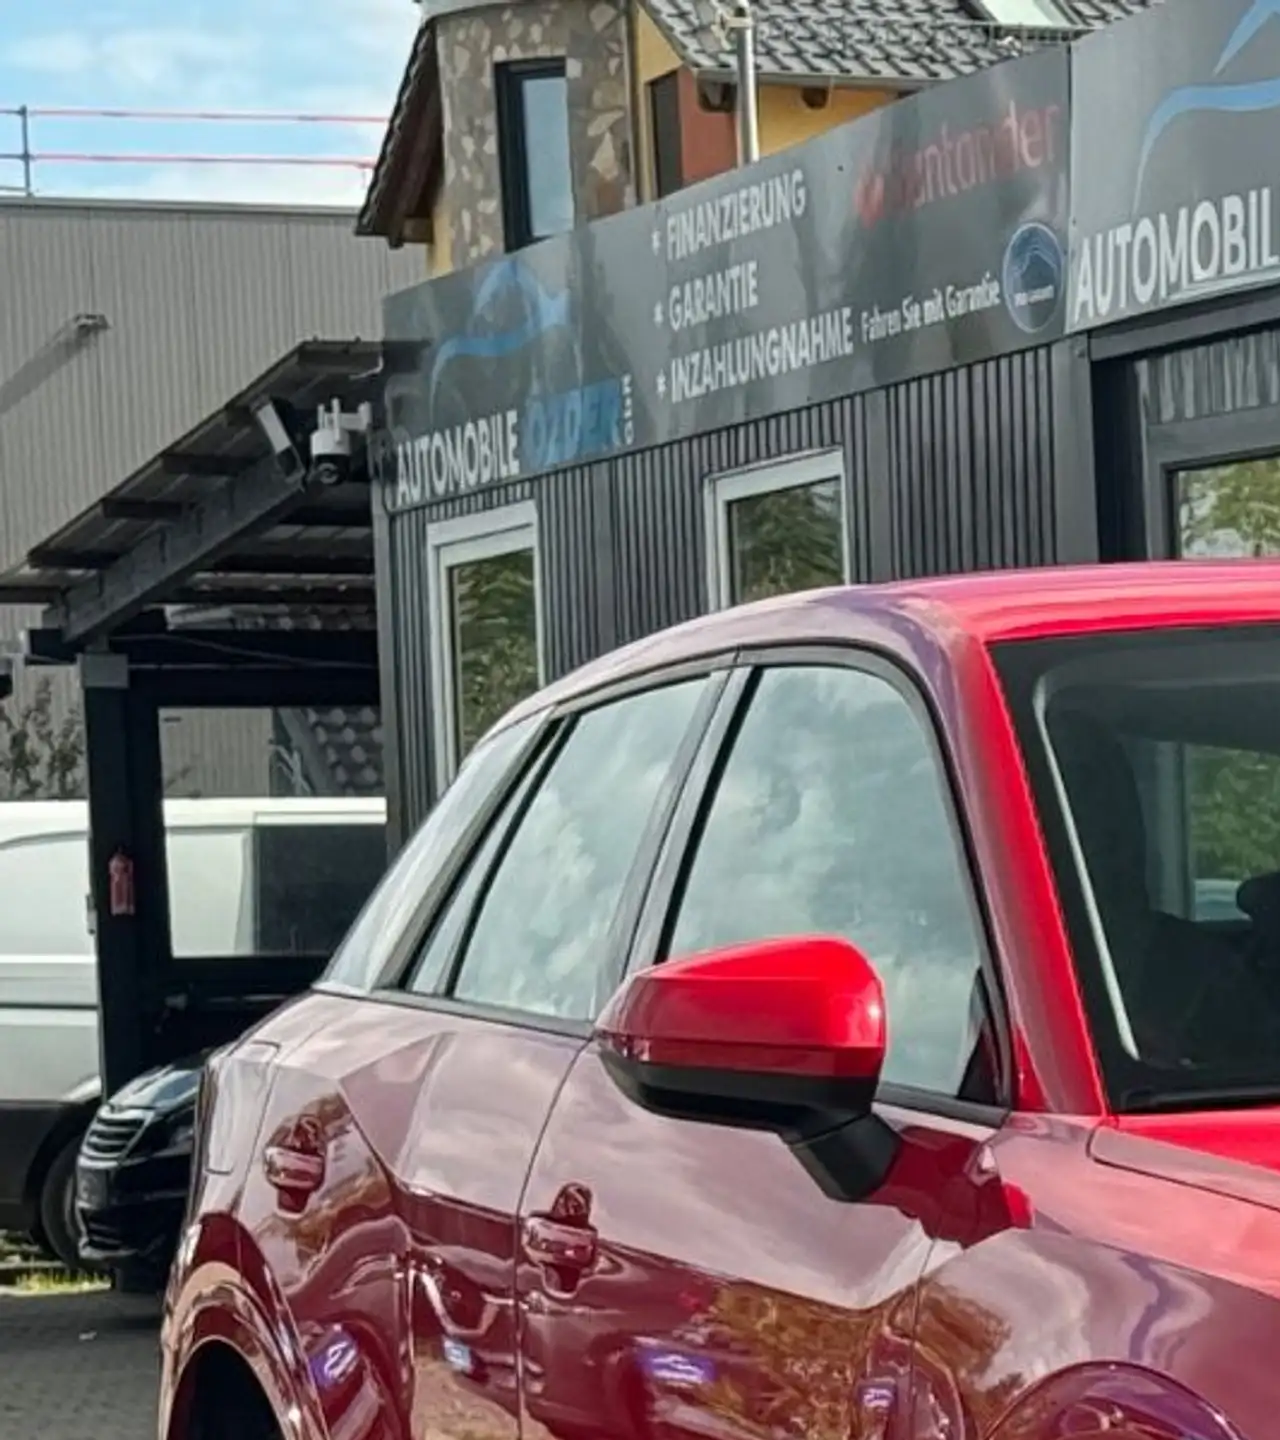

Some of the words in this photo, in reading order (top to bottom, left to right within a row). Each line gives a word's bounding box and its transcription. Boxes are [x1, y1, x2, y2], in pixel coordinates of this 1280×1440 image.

[666, 168, 807, 261] FINANZIERUNG
[668, 260, 759, 332] GARANTIE
[861, 303, 901, 345] Fahren
[901, 293, 922, 332] Sie
[923, 287, 945, 326] mit
[946, 269, 1001, 320] Garantie
[670, 305, 854, 404] INZAHLUNGNAHME
[397, 409, 520, 509] AUTOMOBILE
